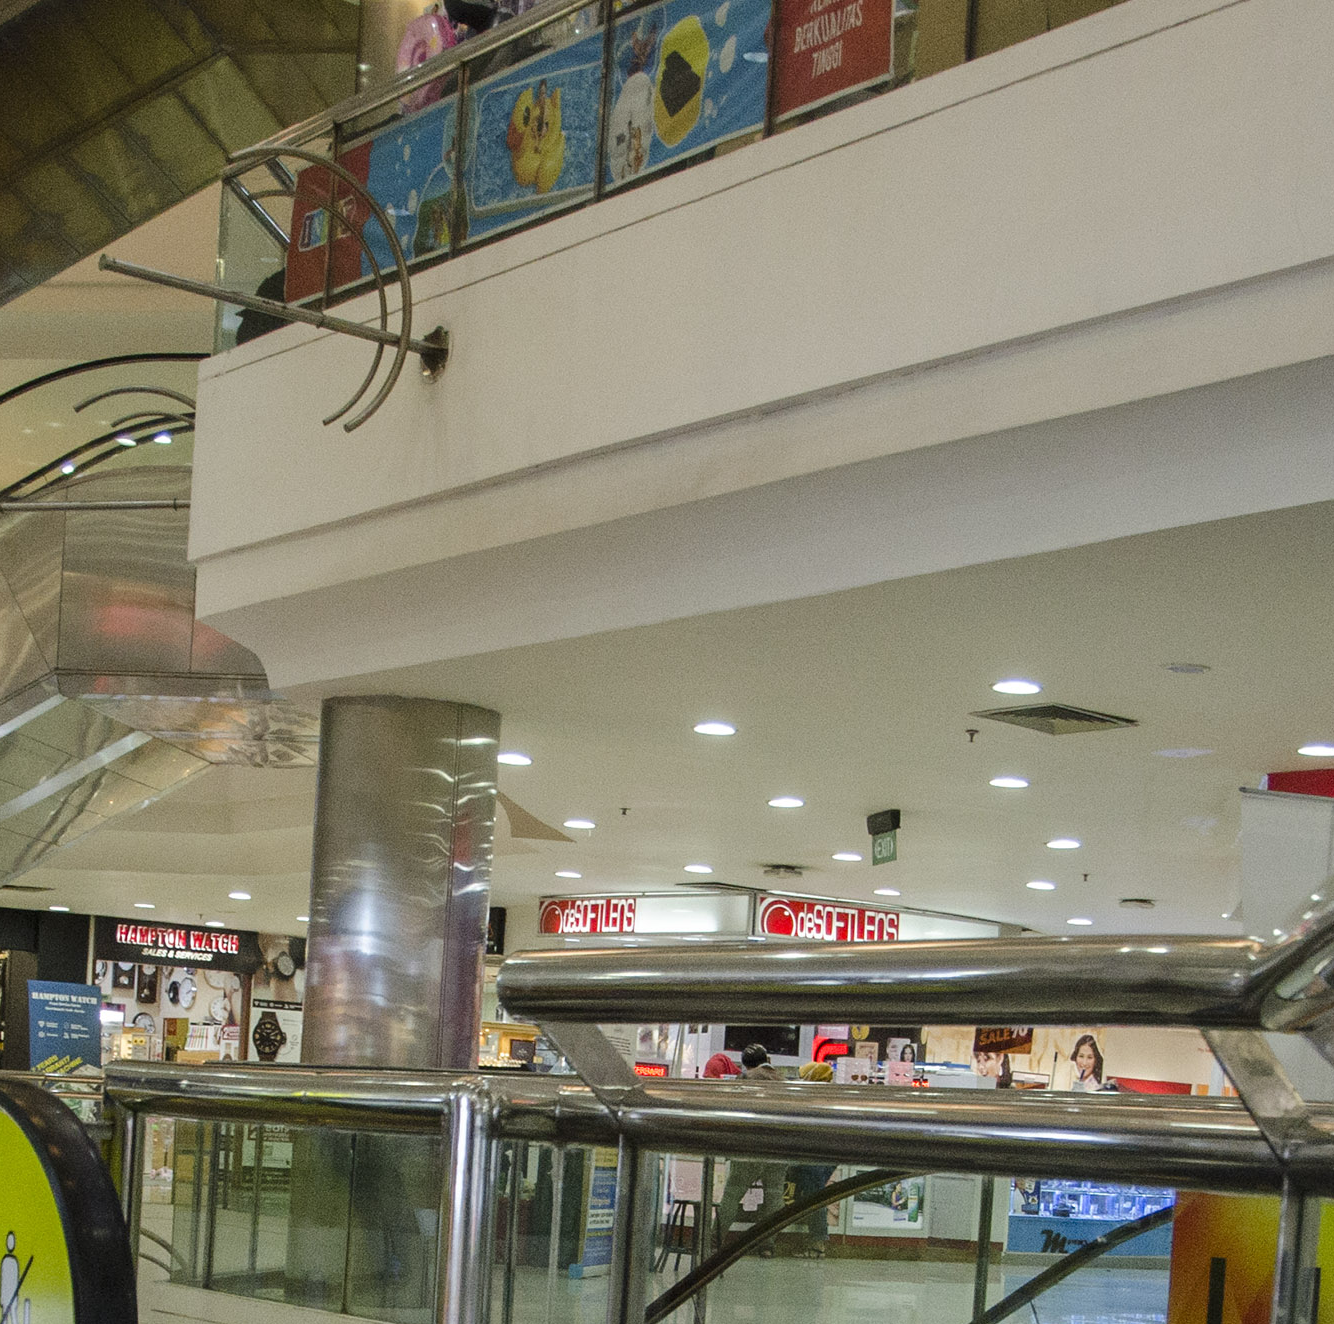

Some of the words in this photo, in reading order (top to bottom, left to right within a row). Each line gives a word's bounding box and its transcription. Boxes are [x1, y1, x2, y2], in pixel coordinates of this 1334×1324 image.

[116, 923, 187, 950] HAMPTON
[190, 930, 240, 954] WATCH
[141, 947, 167, 958] SALES
[175, 950, 214, 961] SERVICES
